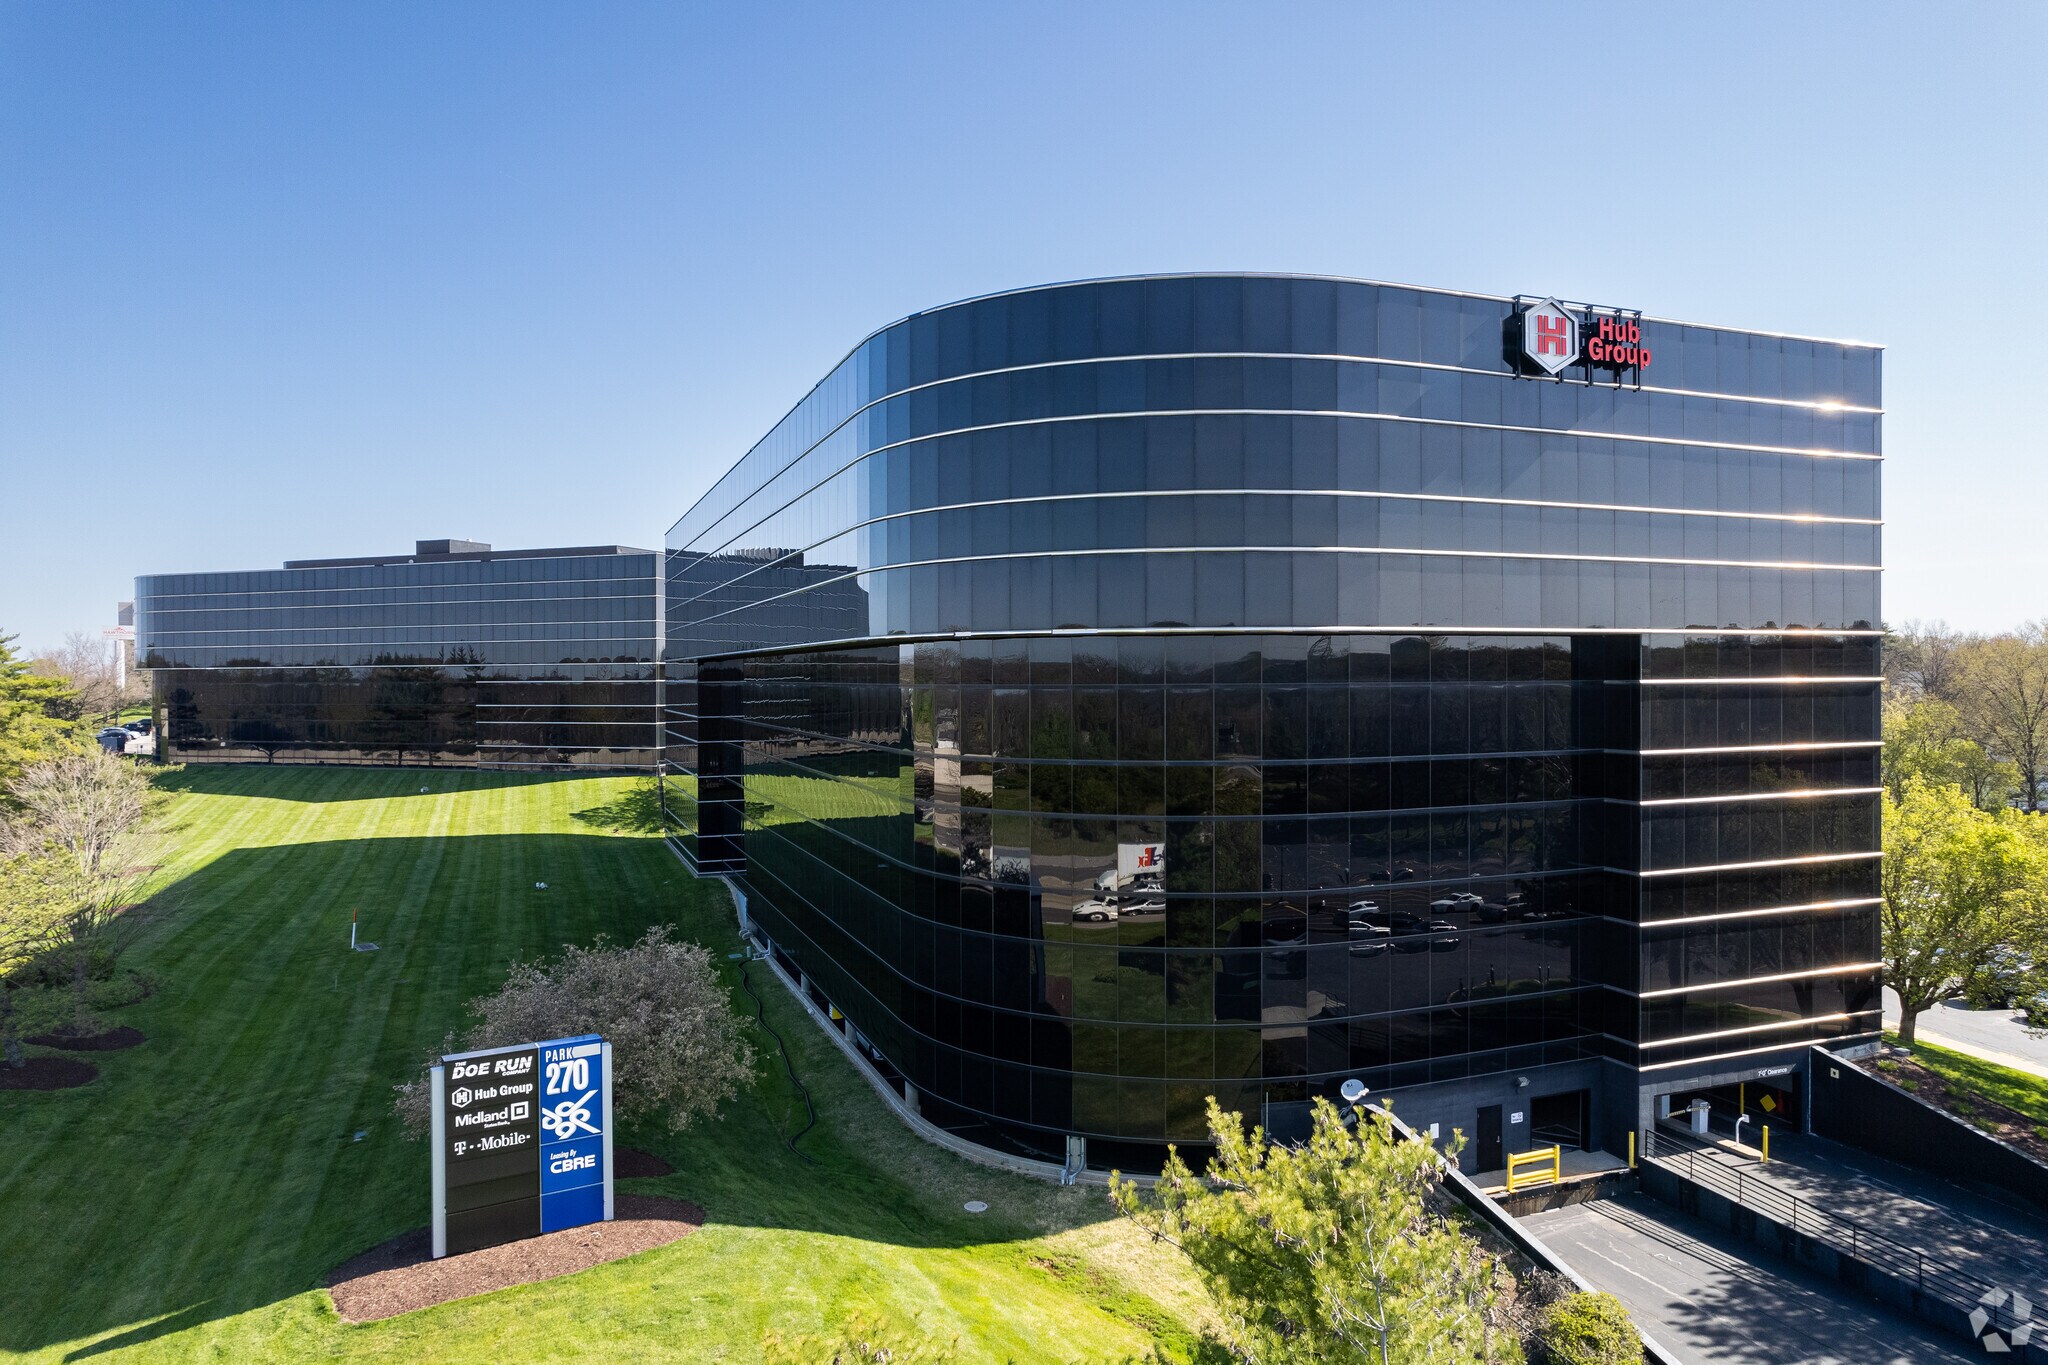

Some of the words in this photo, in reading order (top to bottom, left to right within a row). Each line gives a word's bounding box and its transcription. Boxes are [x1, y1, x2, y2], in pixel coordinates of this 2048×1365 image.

[1600, 317, 1641, 344] Hub
[1588, 337, 1652, 371] Group
[545, 1047, 573, 1063] PARK
[451, 1062, 491, 1080] DOE
[494, 1056, 533, 1073] RUN
[501, 1068, 531, 1077] COMPANY
[546, 1058, 589, 1096] 270
[1767, 1067, 1788, 1075] Clearance
[474, 1087, 498, 1100] Hub
[499, 1082, 533, 1095] Group
[455, 1107, 508, 1128] Midland
[550, 1151, 569, 1160] Leasing
[570, 1149, 577, 1158] By
[550, 1154, 596, 1174] CBRE
